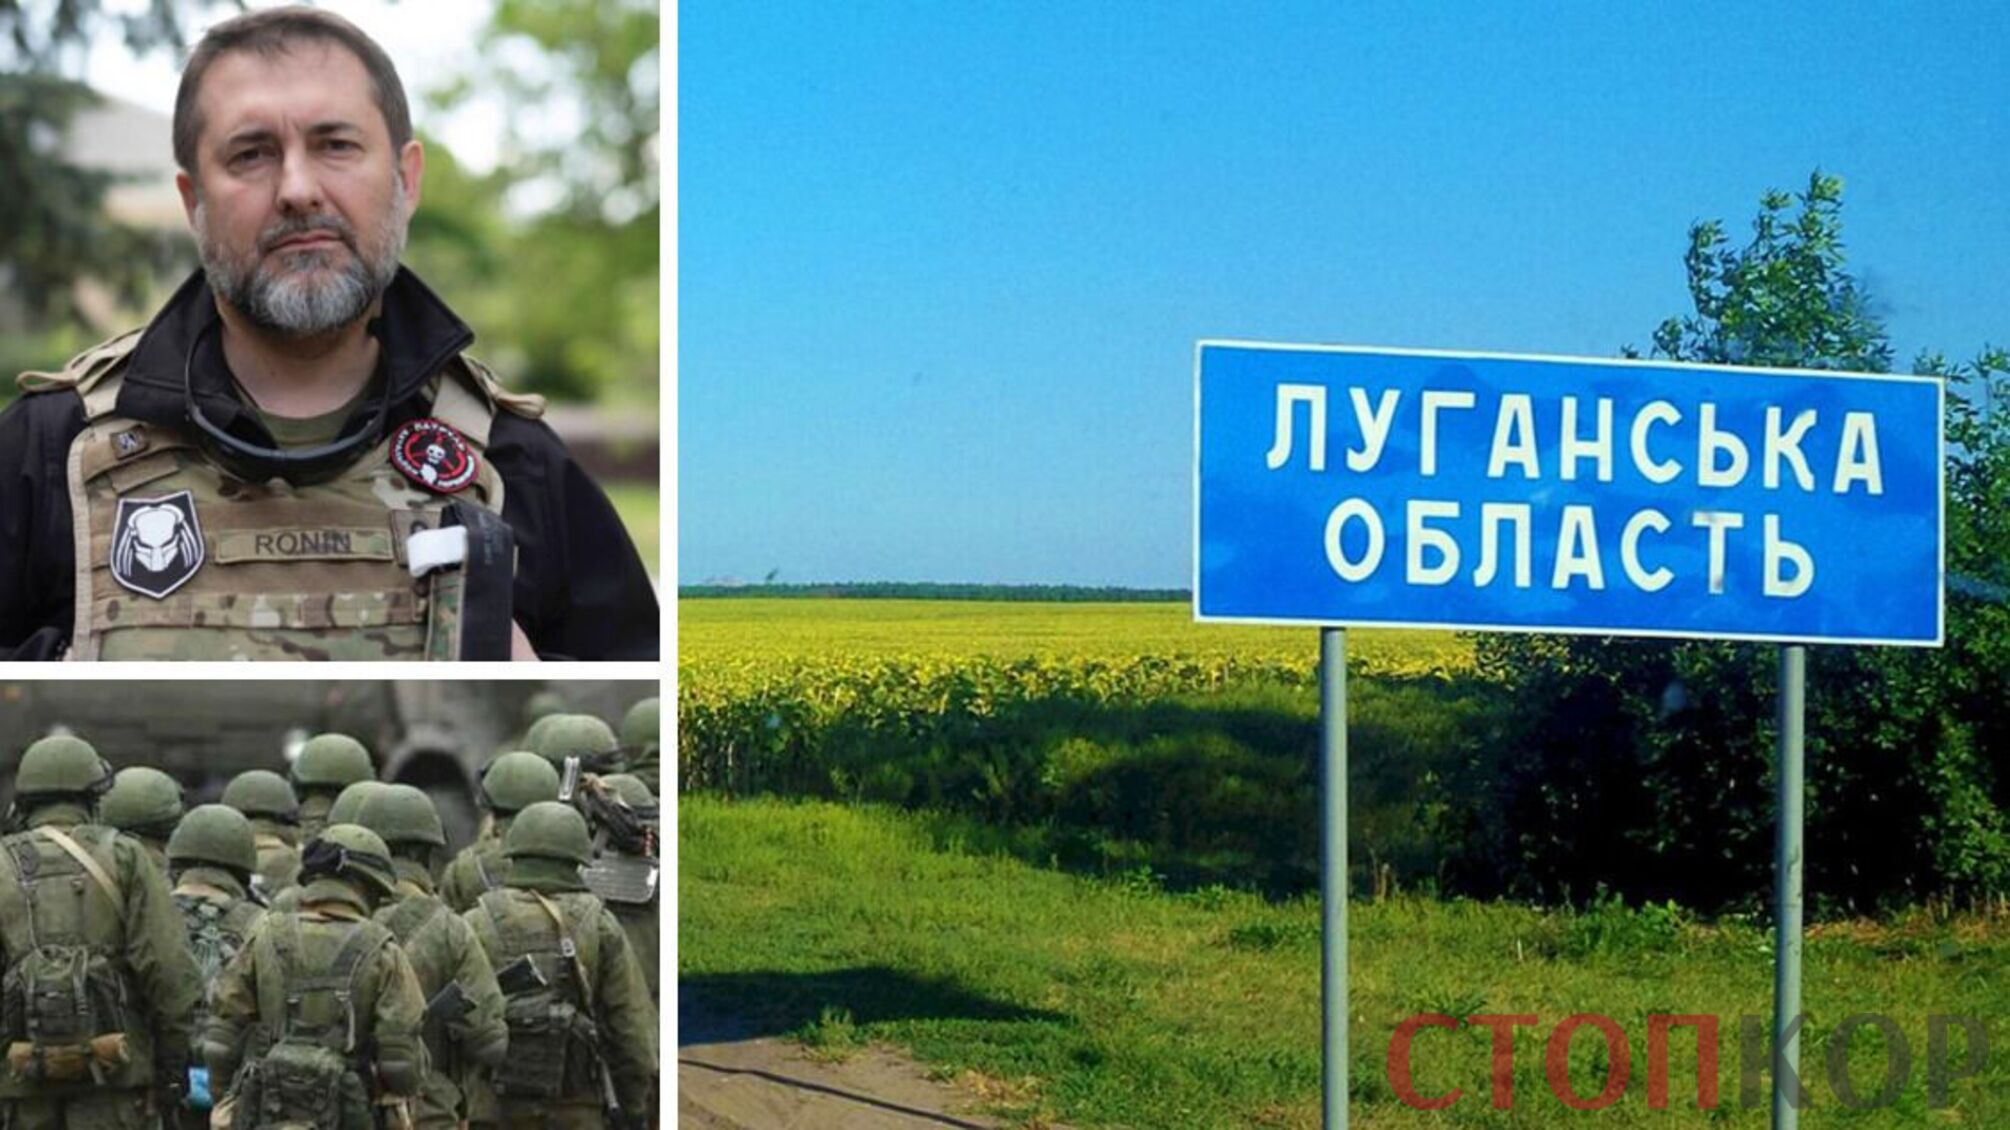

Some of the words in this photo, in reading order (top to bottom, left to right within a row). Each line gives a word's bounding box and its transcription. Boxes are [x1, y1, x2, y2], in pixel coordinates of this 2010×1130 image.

[1266, 382, 1883, 495] ЛУГАНСЬКА
[255, 530, 352, 555] RONIN
[1324, 496, 1816, 598] ОБЛАСТЬ
